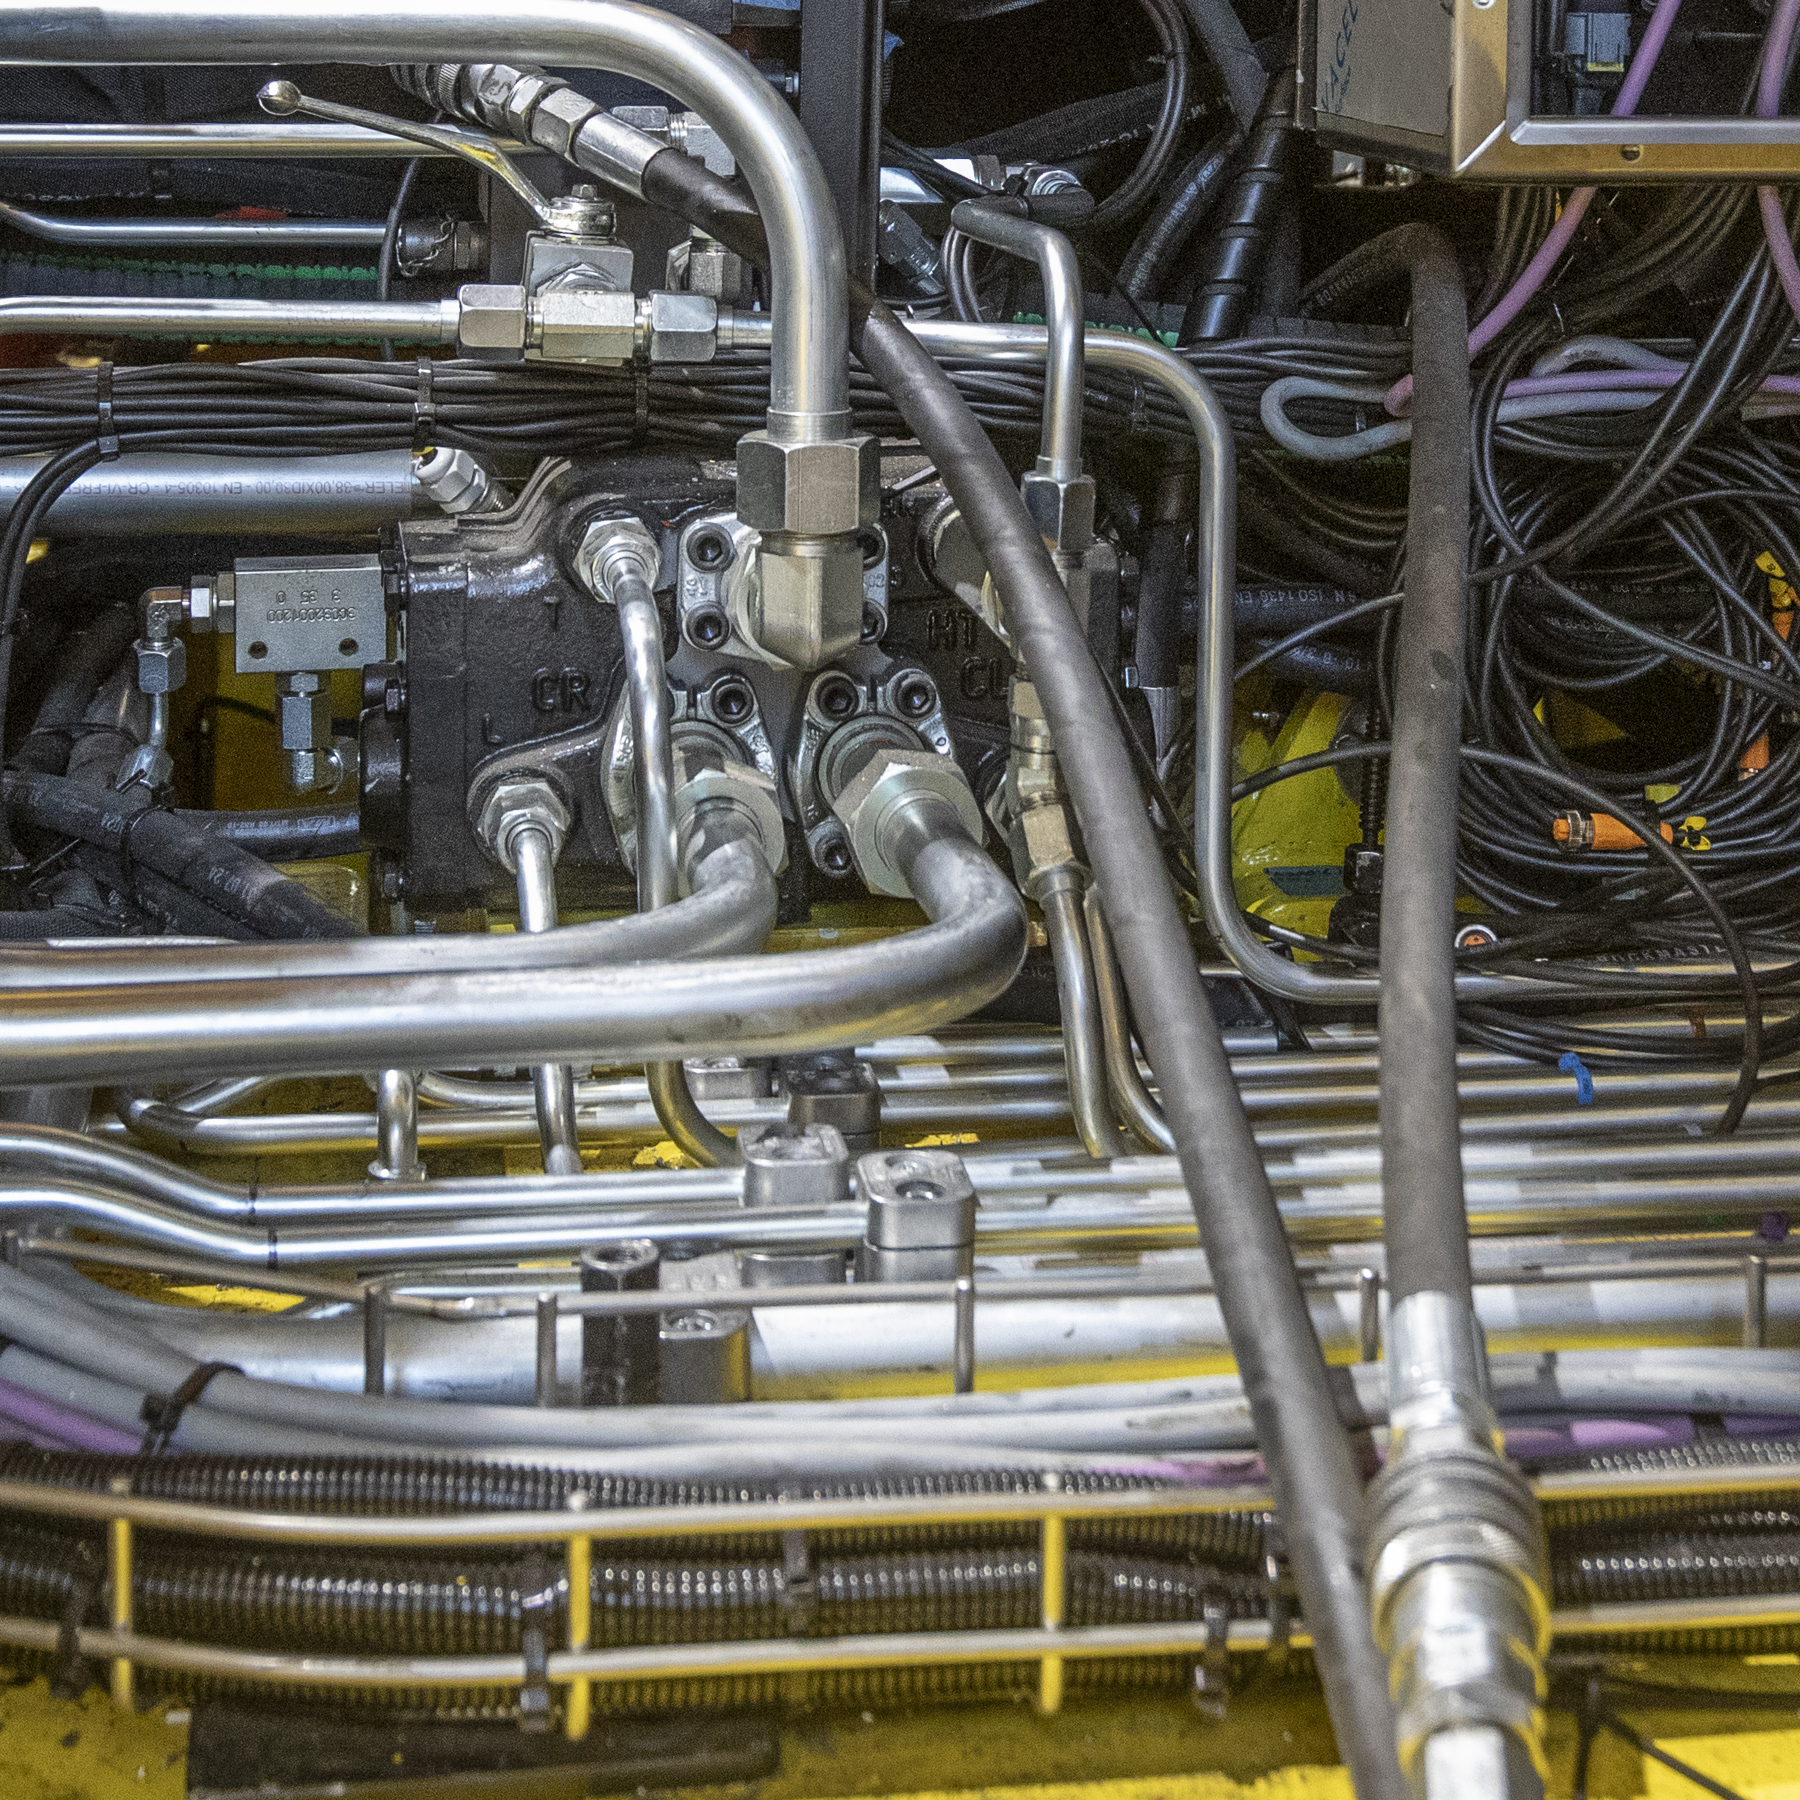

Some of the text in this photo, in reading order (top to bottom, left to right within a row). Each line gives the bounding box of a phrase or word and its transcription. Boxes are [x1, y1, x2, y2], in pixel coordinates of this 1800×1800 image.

[222, 480, 243, 493] EN
[1258, 587, 1294, 603] 1436
[1298, 587, 1323, 602] ISO
[530, 665, 592, 714] CR
